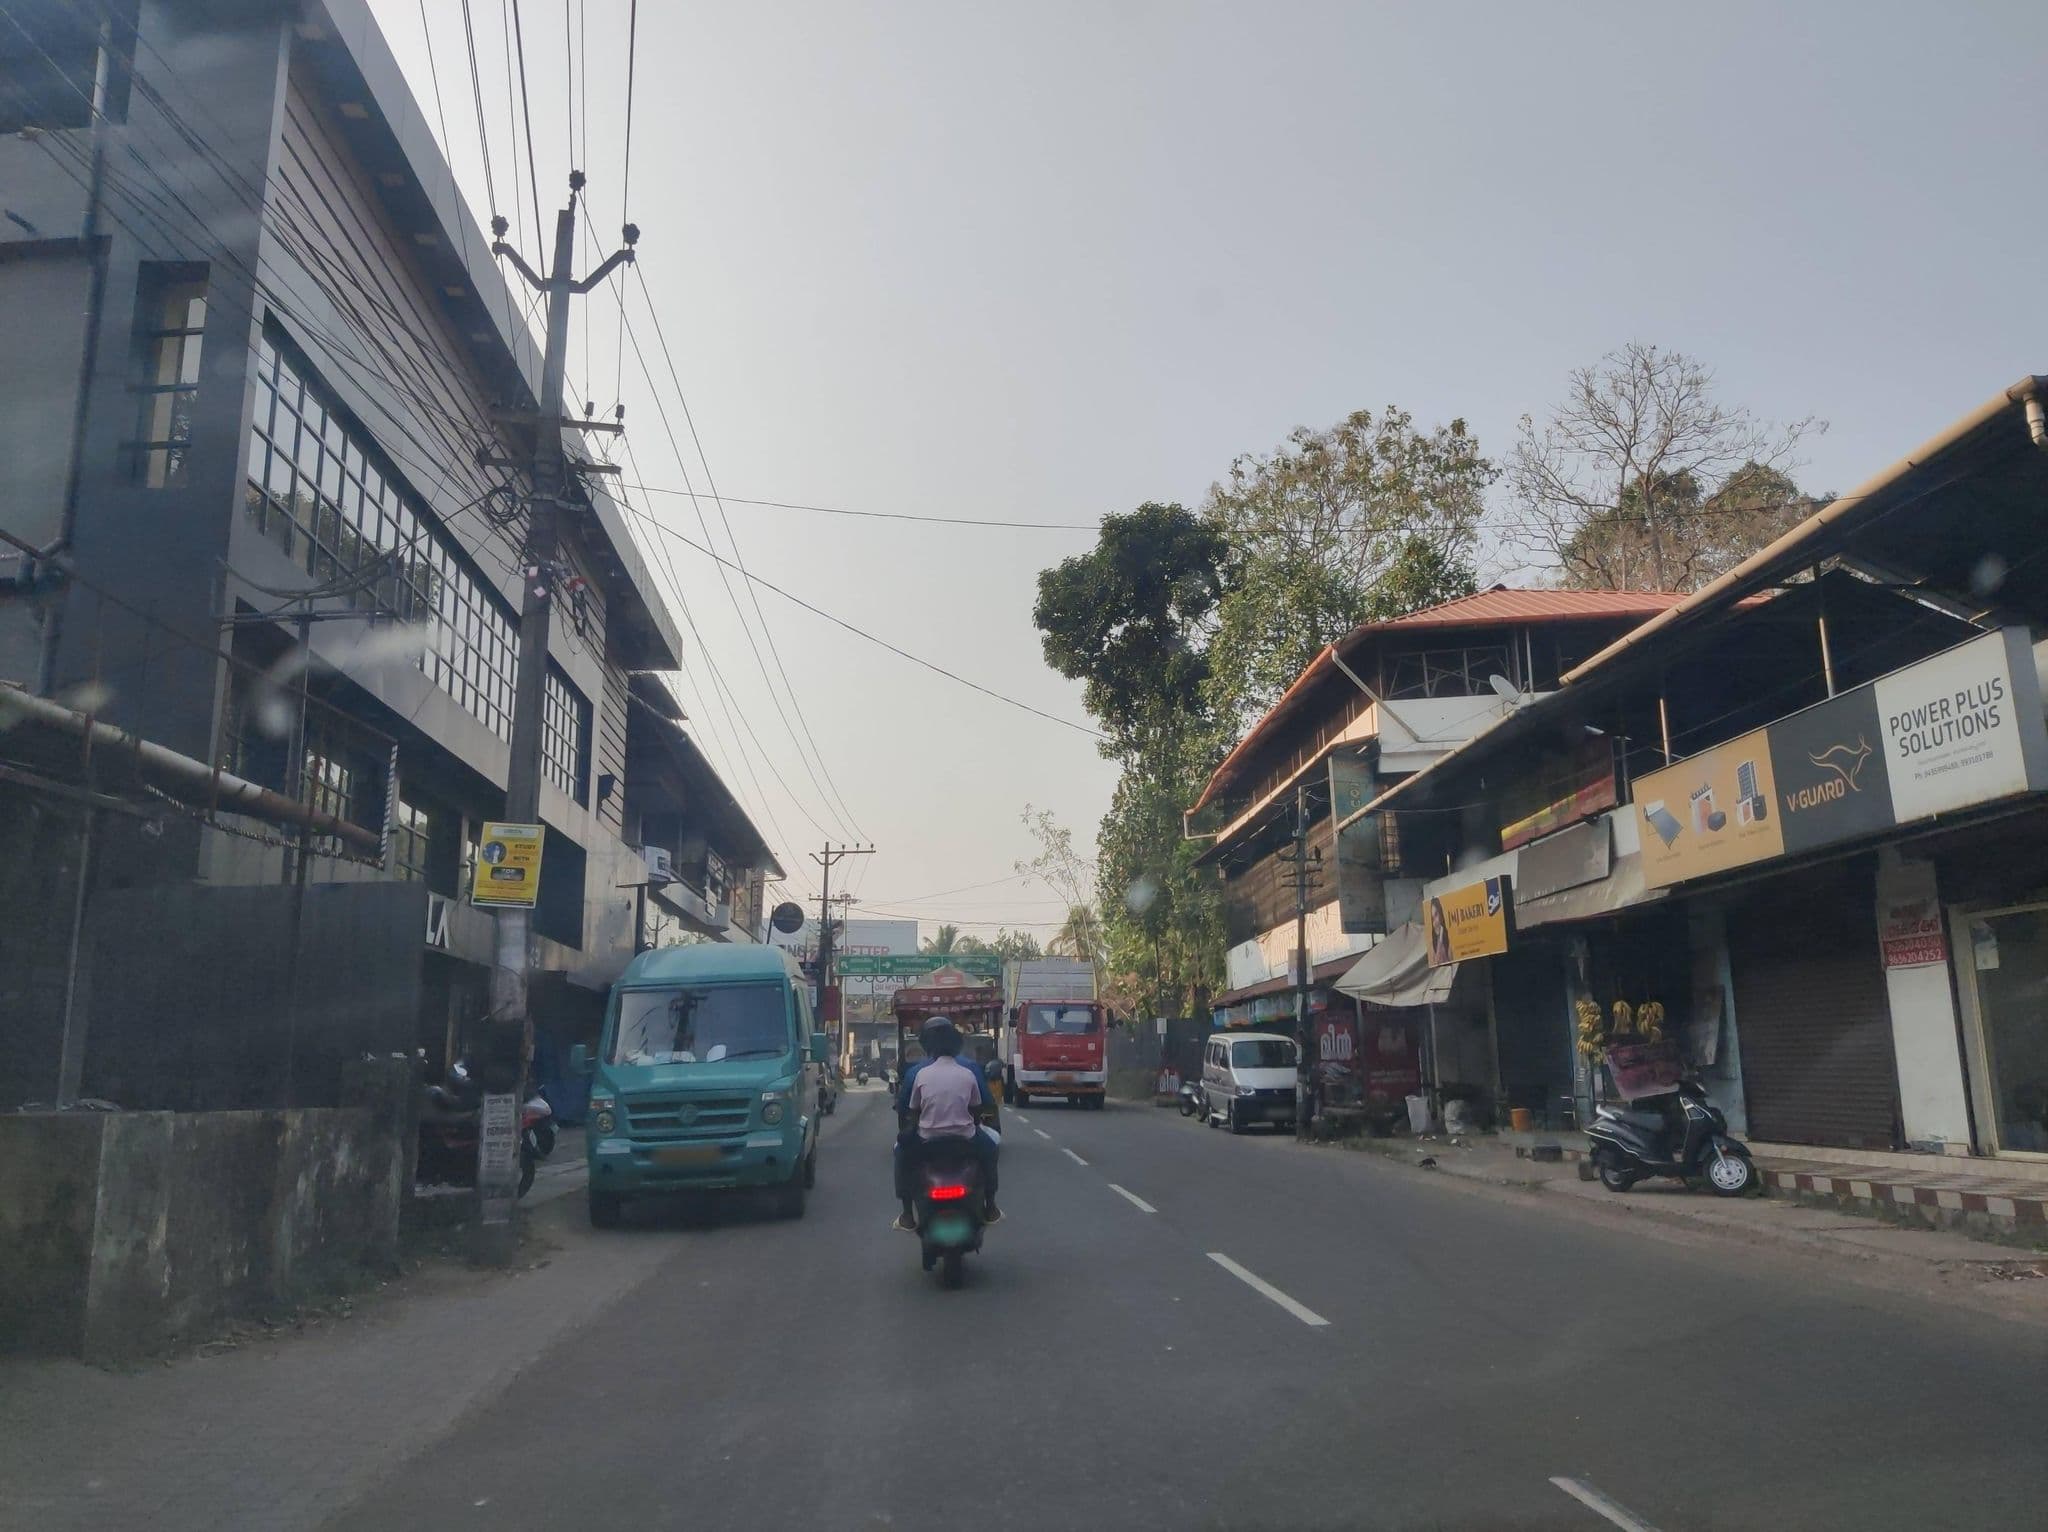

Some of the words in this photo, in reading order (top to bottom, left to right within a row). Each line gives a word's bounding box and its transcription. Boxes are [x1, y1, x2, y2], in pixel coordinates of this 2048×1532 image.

[1889, 697, 1952, 736] POWER
[1955, 677, 2004, 714] PLUS
[1899, 704, 2001, 758] SOLUTIONS
